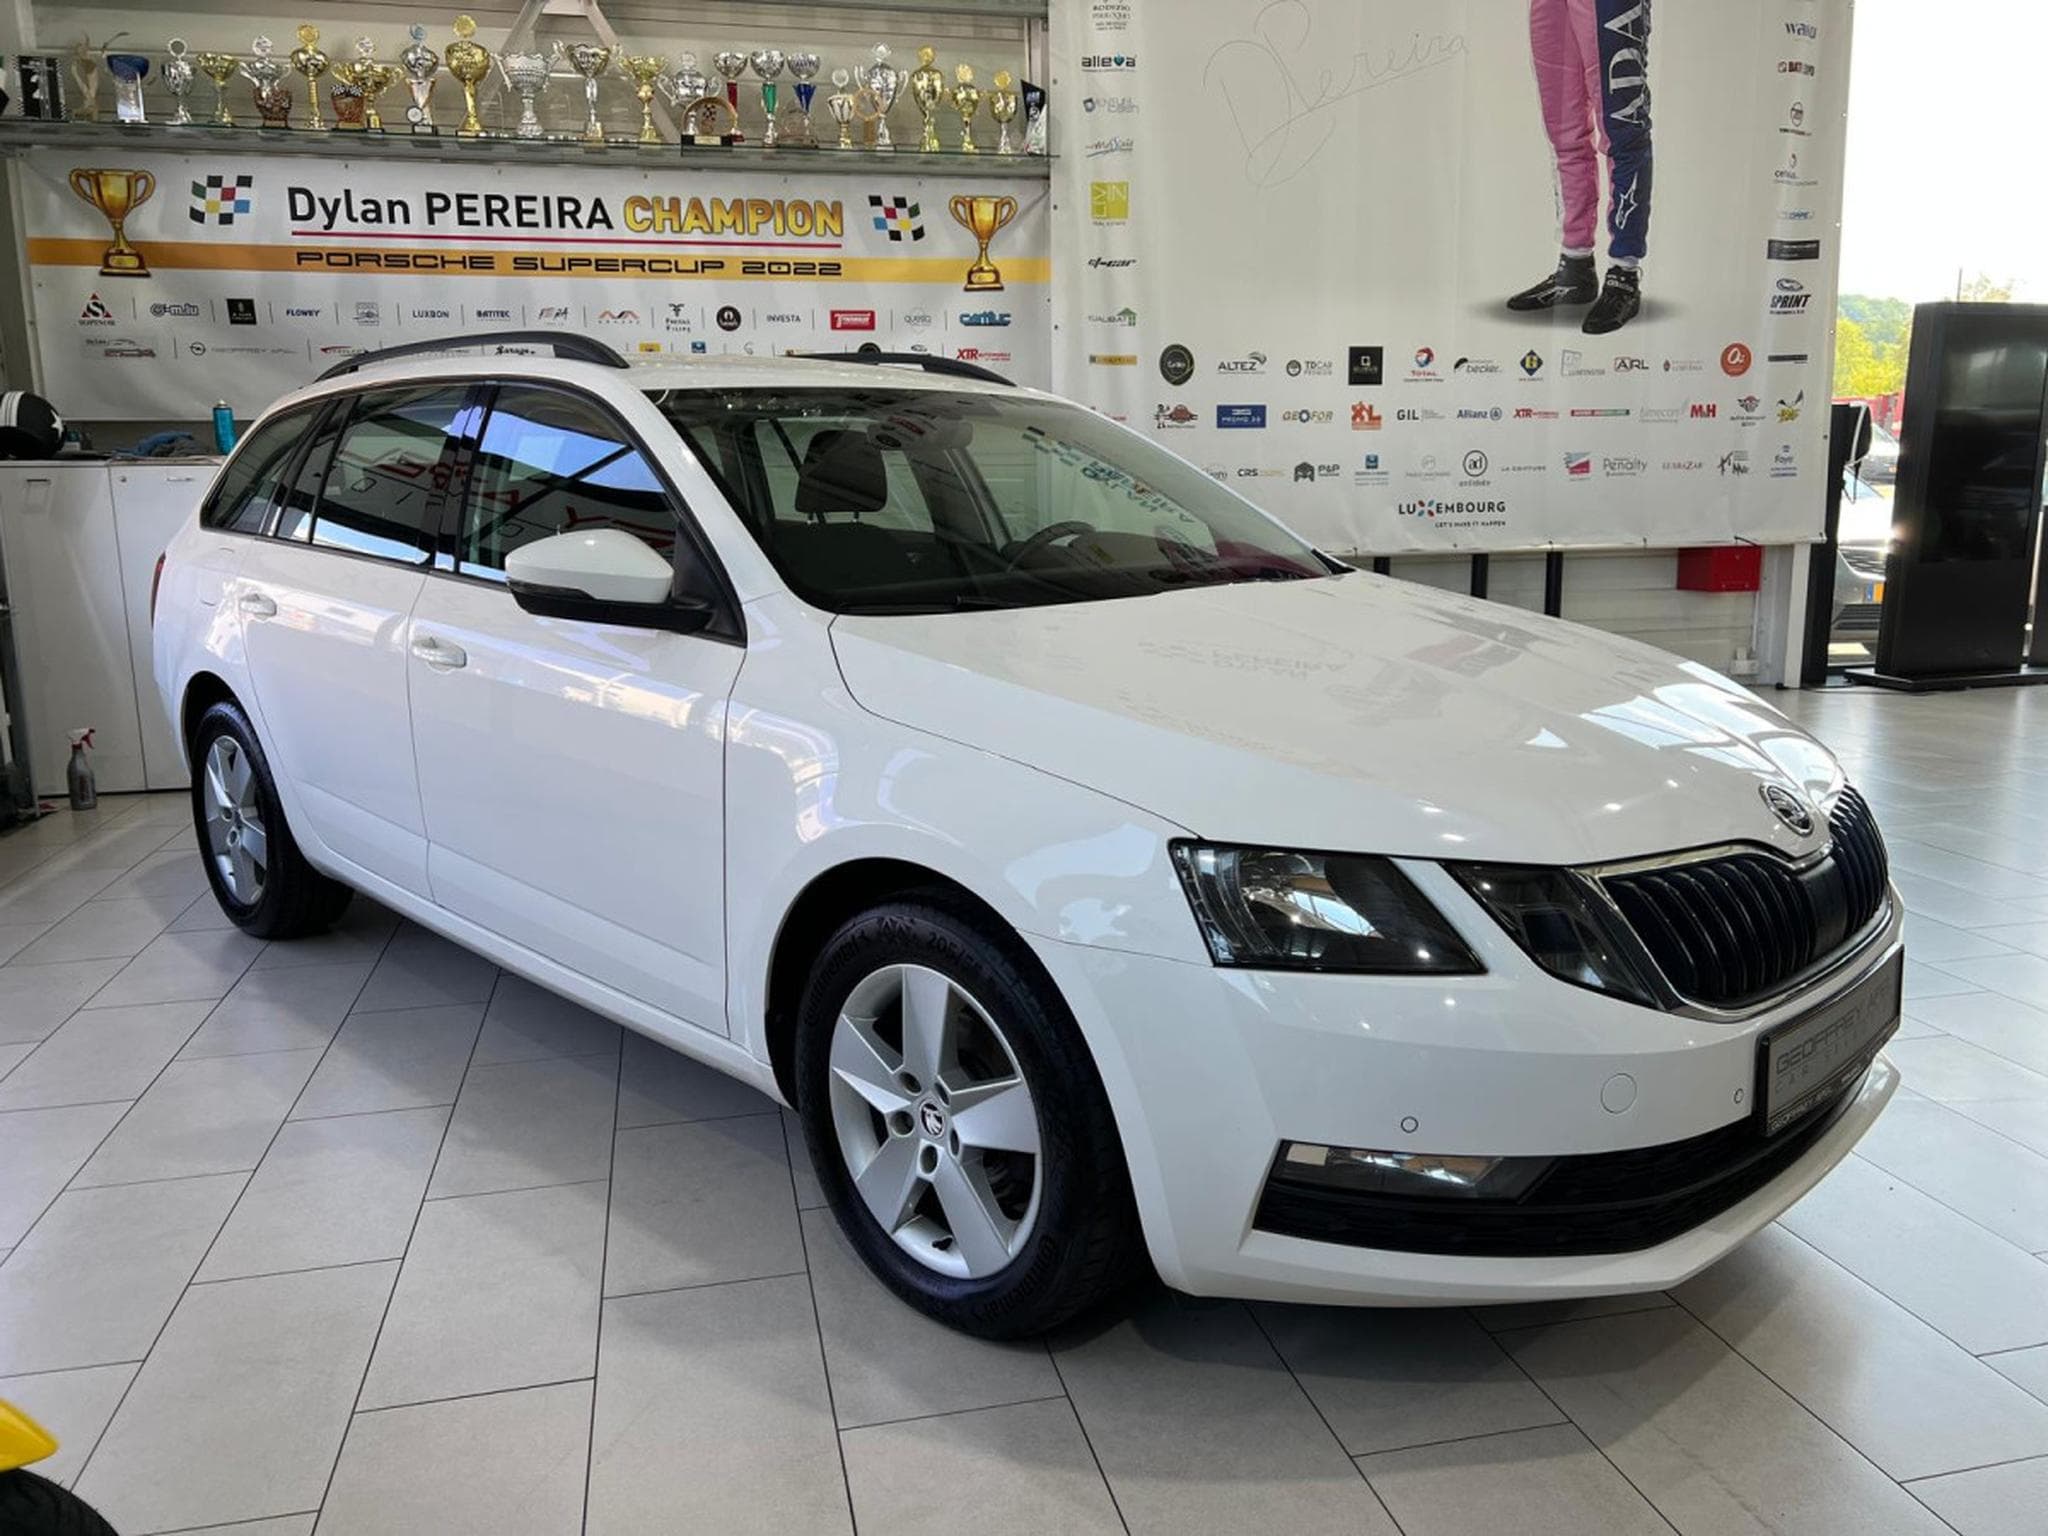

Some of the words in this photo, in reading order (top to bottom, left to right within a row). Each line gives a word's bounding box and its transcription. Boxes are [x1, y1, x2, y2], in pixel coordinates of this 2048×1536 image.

[288, 186, 411, 232] Dylan
[427, 192, 612, 230] PEREIRA
[623, 194, 845, 237] CHAMPION
[297, 251, 496, 270] PORSCHE
[513, 256, 725, 275] SUPERCUP
[742, 260, 842, 276] 2022
[1770, 294, 1811, 308] SPRINT
[767, 314, 801, 323] INVESTA
[1218, 361, 1257, 371] ALTEZ
[1282, 409, 1334, 423] GEOFOR
[1396, 409, 1419, 421] GIL
[1457, 408, 1489, 420] Allianz
